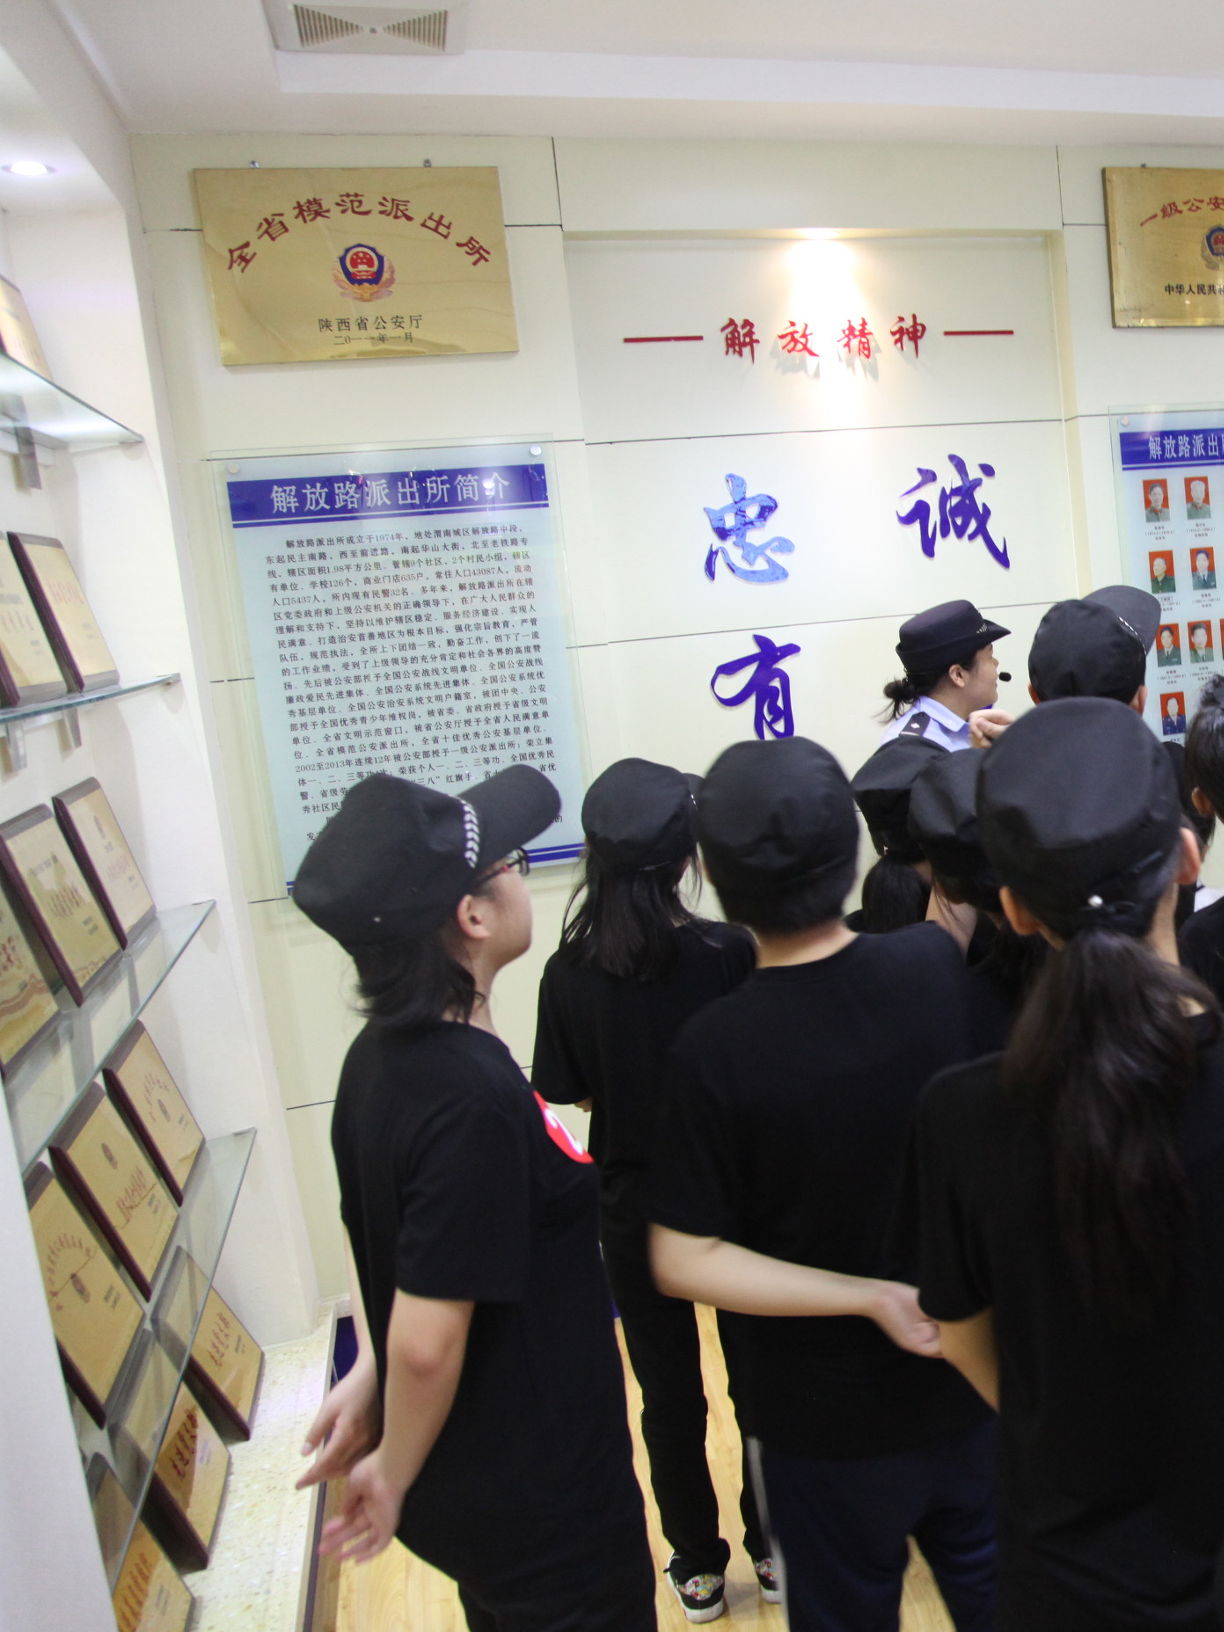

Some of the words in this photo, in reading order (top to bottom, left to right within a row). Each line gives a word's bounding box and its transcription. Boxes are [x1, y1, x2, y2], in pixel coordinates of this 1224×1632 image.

[227, 192, 492, 273] 全省模范派出所
[318, 314, 422, 332] 陕西省公安厅
[720, 313, 927, 363] 解放精神
[271, 472, 511, 514] 解放路派出所简介
[711, 634, 801, 741] 有
